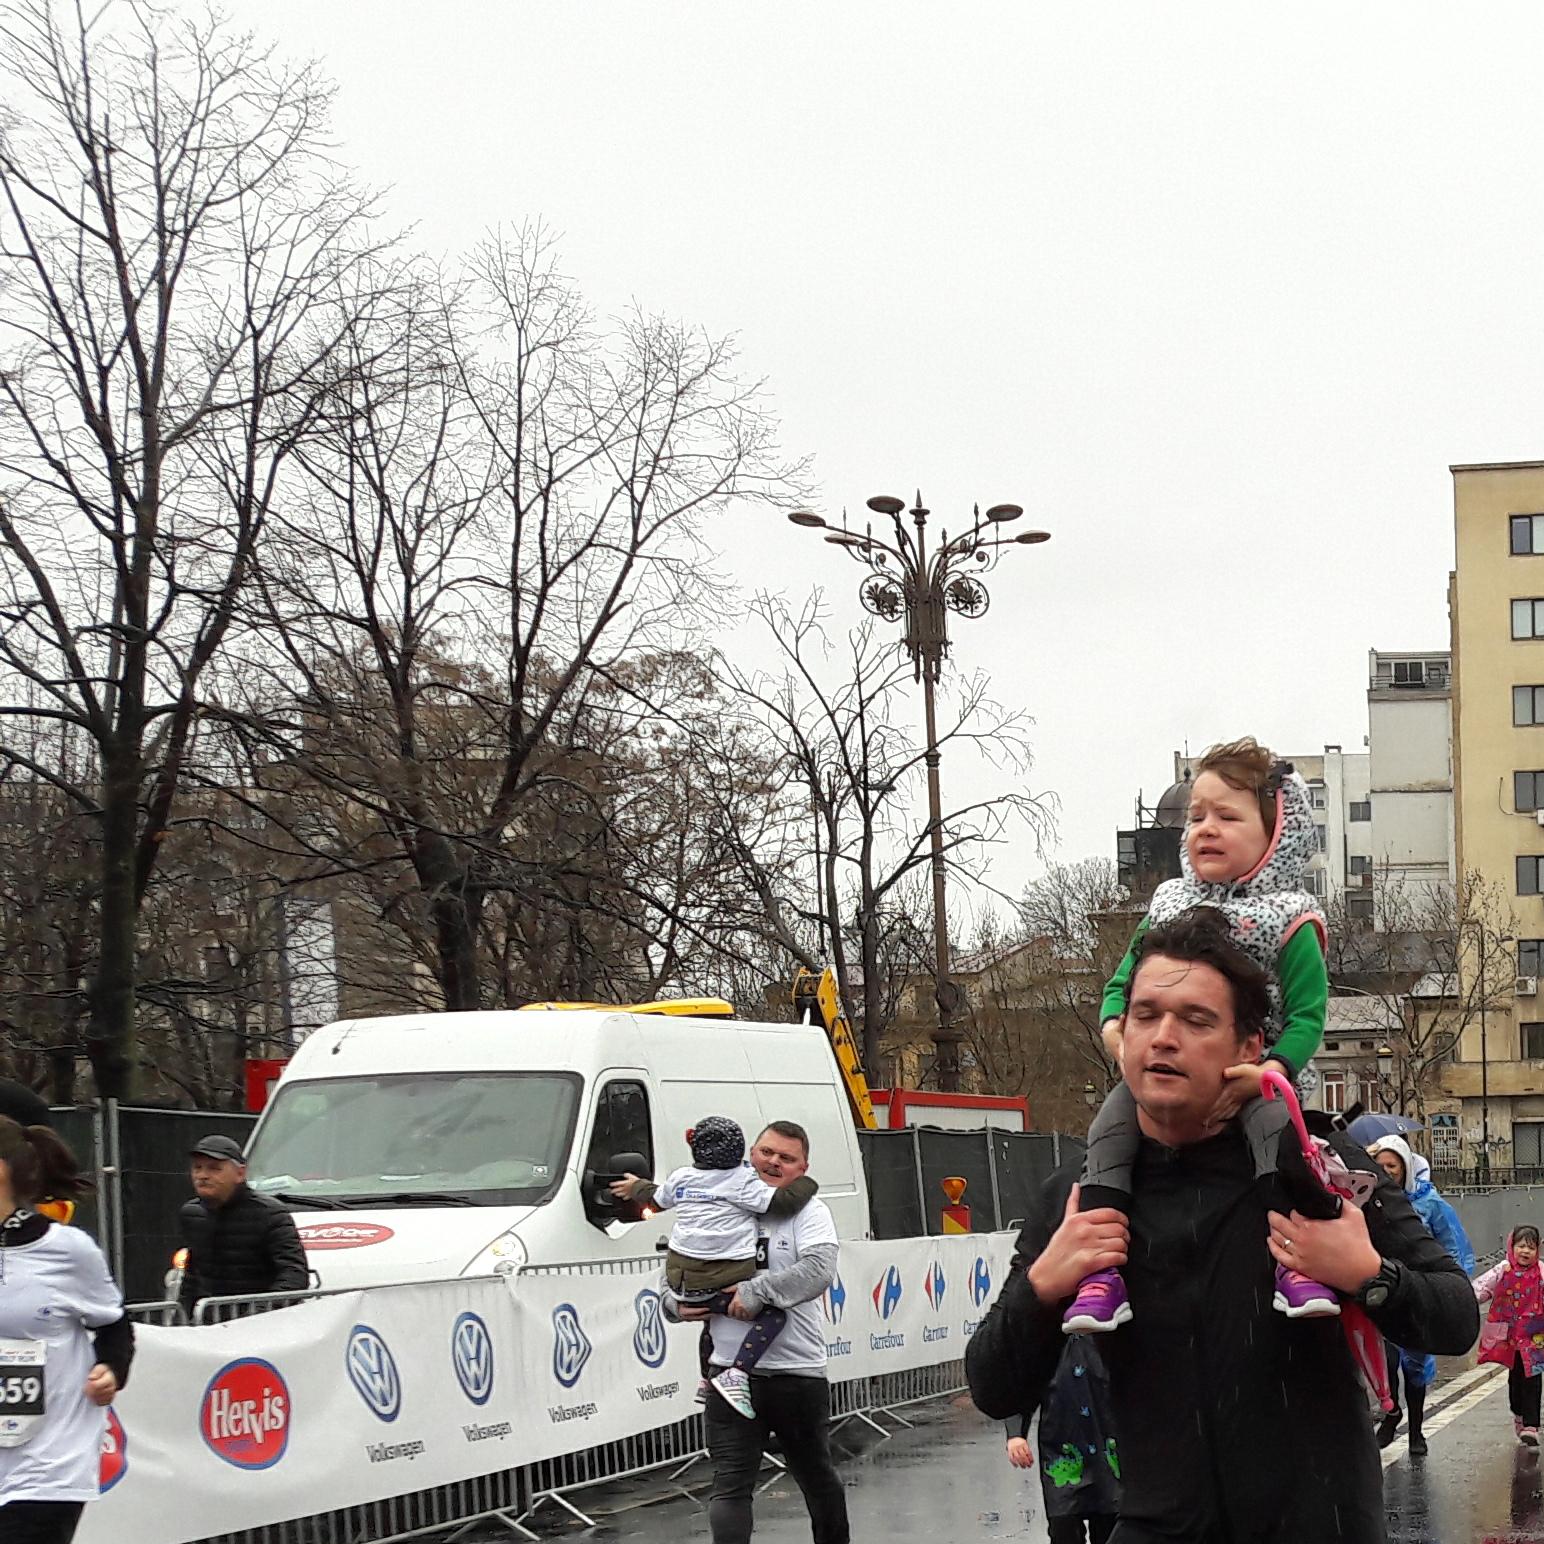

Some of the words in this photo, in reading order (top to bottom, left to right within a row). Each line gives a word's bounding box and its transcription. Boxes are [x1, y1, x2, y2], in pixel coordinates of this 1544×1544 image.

[636, 1382, 680, 1402] Volkswagen
[211, 1387, 285, 1444] Hervis
[548, 1402, 598, 1423] Volkswagen
